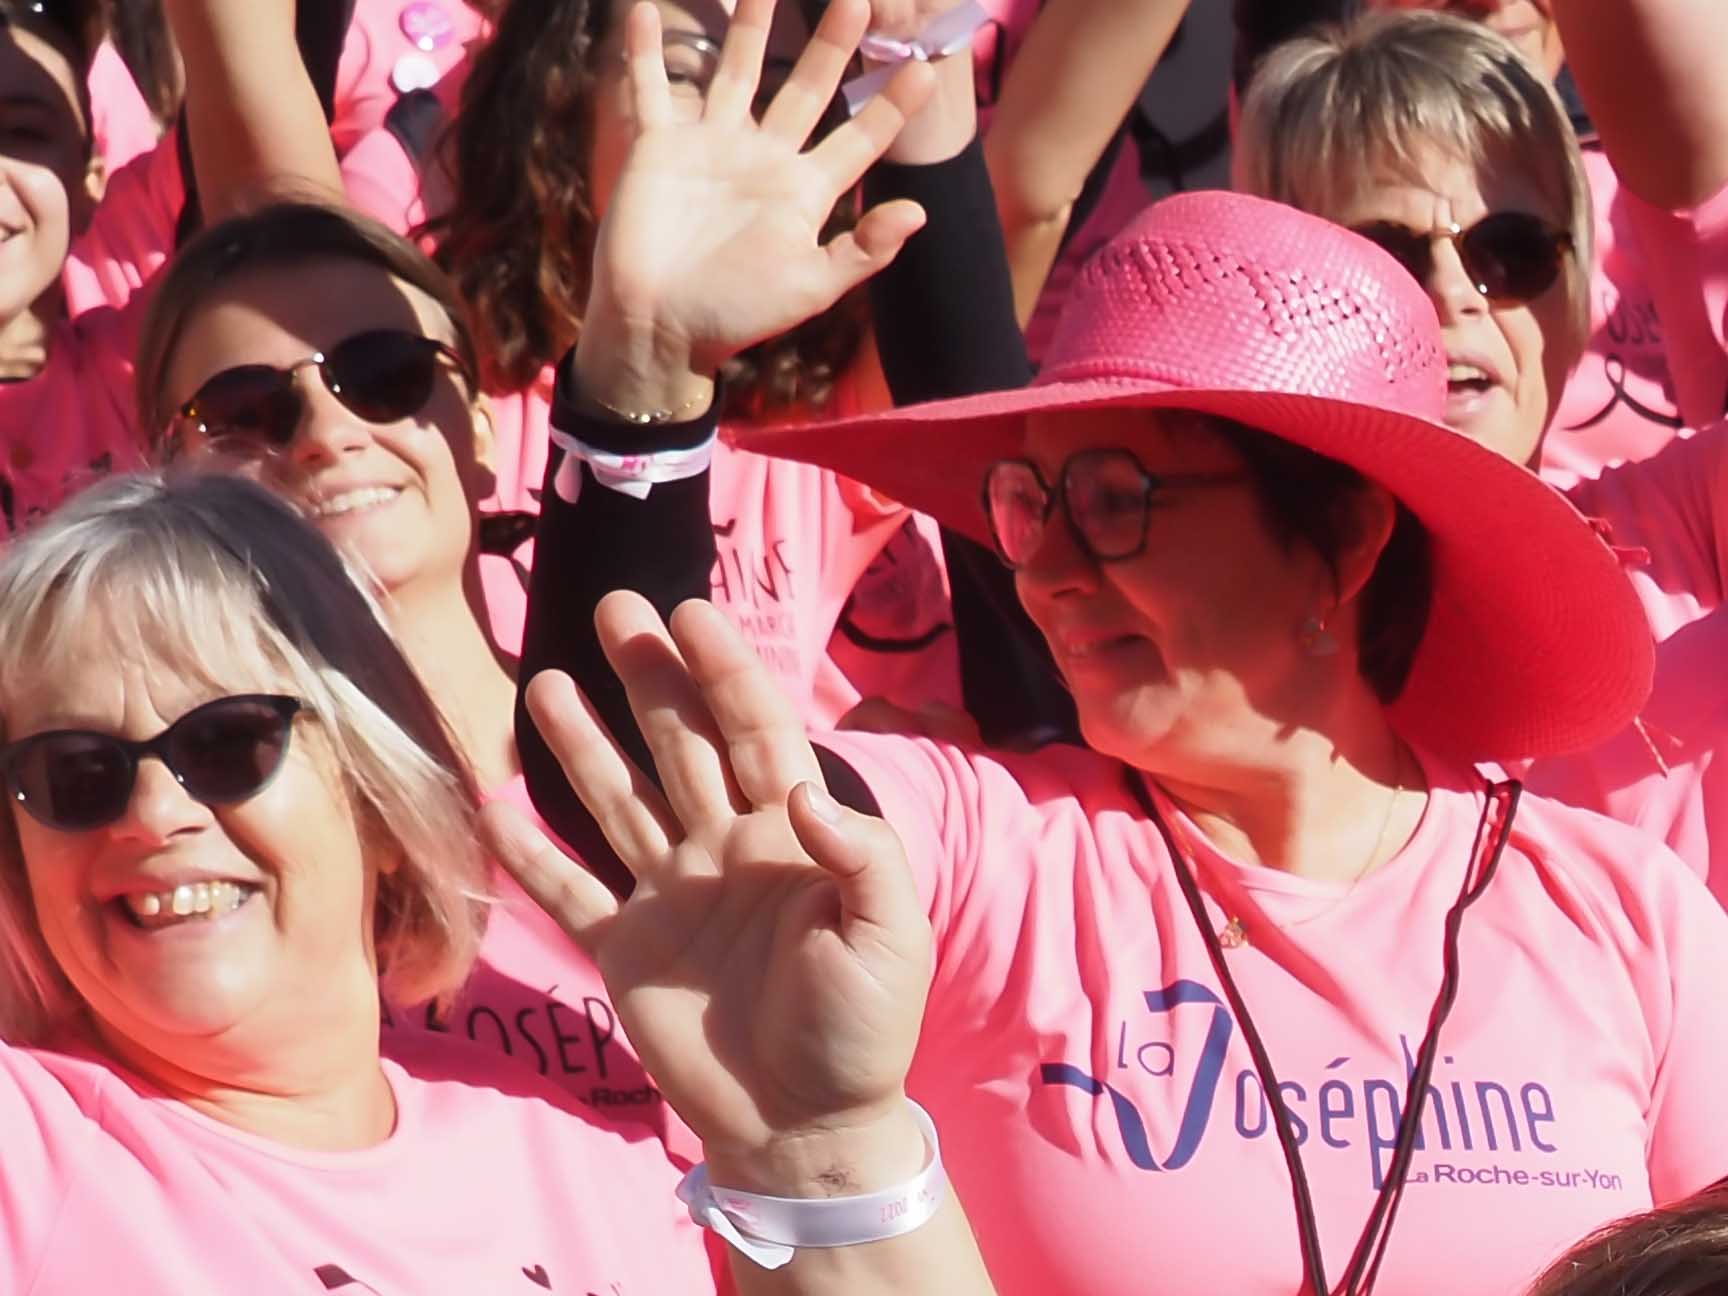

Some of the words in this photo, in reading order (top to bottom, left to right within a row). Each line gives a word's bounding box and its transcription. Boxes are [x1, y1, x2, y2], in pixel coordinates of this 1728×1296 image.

[1117, 1021, 1175, 1077] la
[1040, 979, 1559, 1191] Joséphine
[1434, 1163, 1623, 1192] Roche-sur-Yon
